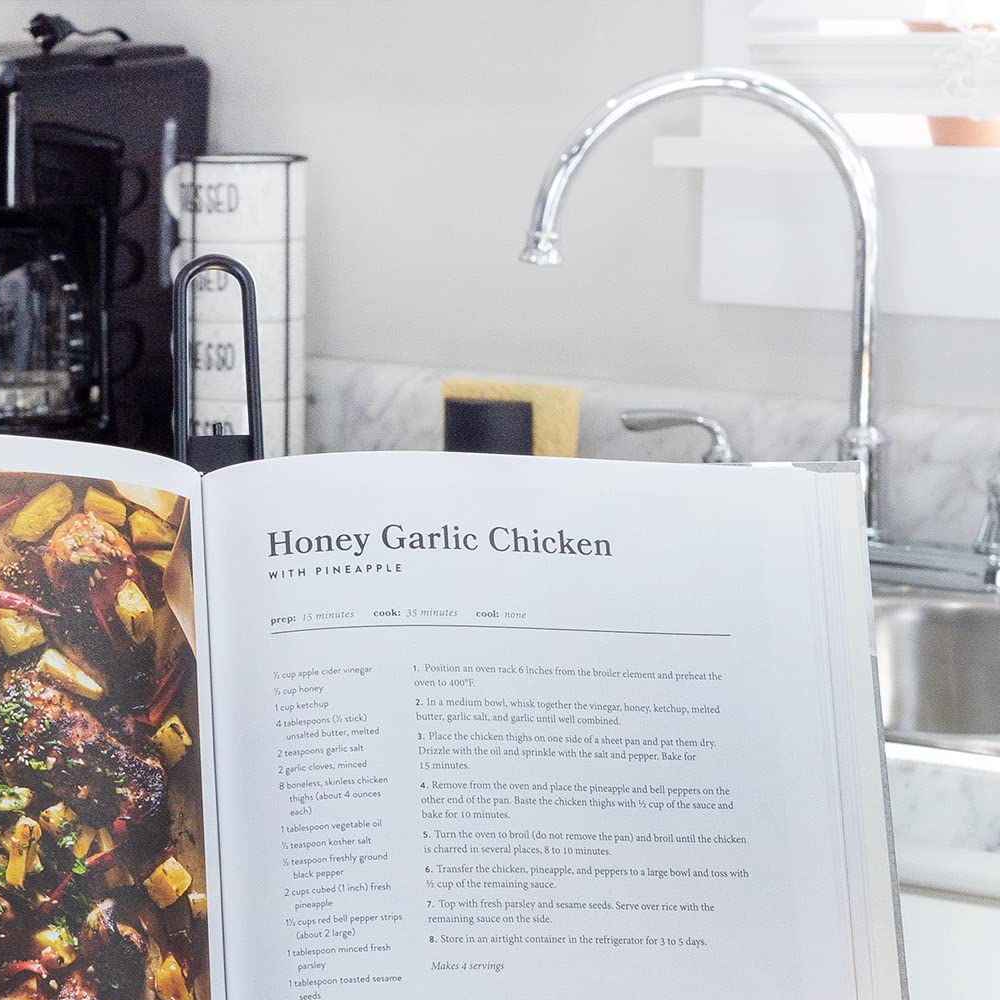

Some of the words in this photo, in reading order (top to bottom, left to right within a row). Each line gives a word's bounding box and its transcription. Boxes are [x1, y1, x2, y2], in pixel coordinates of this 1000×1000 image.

[267, 529, 371, 557] Honey
[381, 524, 478, 551] Garlic
[488, 526, 613, 557] Chicken
[268, 568, 306, 580] WITH
[315, 563, 402, 576] PINEAPPLE
[270, 615, 296, 627] prep:
[303, 613, 312, 622] 15
[316, 610, 354, 620] minutes
[373, 608, 401, 617] cook:
[406, 609, 418, 618] 35
[420, 607, 458, 617] minutes
[475, 609, 500, 618] cool:
[281, 672, 297, 681] cup
[298, 667, 320, 680] apple
[321, 666, 342, 676] cider
[343, 667, 373, 676] vinegar
[424, 663, 461, 673] Position
[498, 664, 517, 674] rack
[518, 665, 524, 674] 6
[525, 665, 553, 675] inches
[554, 666, 576, 676] from
[577, 667, 591, 677] the
[592, 667, 621, 678] broiler
[622, 669, 656, 679] element
[657, 670, 674, 680] and
[675, 671, 707, 683] preheat
[708, 671, 722, 681] the
[437, 679, 447, 687] to
[448, 678, 476, 687] 400°F.
[274, 703, 279, 712] 1
[279, 704, 295, 713] cup
[296, 699, 329, 710] ketchup
[415, 698, 424, 706] 2.
[426, 697, 437, 706] In
[446, 697, 483, 707] medium
[484, 698, 509, 708] bowl,
[509, 698, 536, 709] whisk
[537, 700, 572, 712] together
[573, 700, 588, 710] the
[589, 702, 623, 714] vinegar,
[623, 702, 652, 715] honey,
[653, 703, 690, 716] ketchup,
[691, 704, 721, 714] melted
[286, 729, 320, 741] unsalted
[321, 729, 350, 738] butter,
[350, 726, 380, 736] melted
[277, 749, 283, 758] 2
[284, 748, 324, 759] teaspoons
[326, 744, 348, 757] garlic
[349, 743, 364, 753] salt
[278, 765, 284, 774] 2
[285, 763, 308, 777] garlic
[307, 762, 336, 772] cloves,
[337, 759, 367, 769] minced
[420, 761, 430, 771] 15
[432, 760, 471, 770] minutes.
[278, 781, 285, 791] 8
[286, 779, 323, 790] boneless,
[324, 777, 356, 786] skinless
[356, 775, 389, 785] chicken
[289, 792, 314, 805] thighs
[315, 791, 342, 801] (about
[343, 790, 350, 798] 4
[352, 791, 382, 799] ounces
[290, 805, 313, 817] each)
[281, 825, 284, 833] 1
[286, 823, 330, 834] tablespoon
[331, 819, 371, 832] vegetable
[372, 819, 382, 828] oil
[424, 865, 434, 874] 6.
[435, 863, 474, 873] Transfer
[475, 863, 490, 874] the
[491, 864, 529, 875] chicken,
[530, 865, 575, 877] pineapple,
[576, 865, 593, 875] and
[594, 868, 628, 878] peppers
[629, 868, 639, 876] to
[647, 867, 668, 880] large
[669, 867, 691, 877] bowl
[692, 868, 710, 878] and
[710, 870, 728, 878] toss
[729, 868, 749, 878] with
[284, 888, 290, 897] 2
[291, 888, 310, 898] cups
[311, 883, 336, 895] cubed
[337, 883, 345, 894] (1
[347, 882, 369, 892] inch)
[370, 882, 391, 891] fresh
[294, 898, 333, 913] pineapple
[426, 900, 435, 908] 7.
[437, 899, 456, 911] Top
[458, 898, 478, 908] with
[480, 898, 503, 908] fresh
[504, 899, 536, 911] parsley
[537, 899, 554, 909] and
[588, 900, 614, 910] seeds.
[615, 901, 639, 911] Serve
[640, 903, 660, 911] over
[661, 902, 678, 912] rice
[679, 902, 699, 912] with
[700, 902, 715, 912] the
[429, 935, 438, 943] 8.
[440, 934, 464, 944] Store
[466, 934, 475, 943] in
[490, 933, 523, 946] airtight
[524, 935, 566, 944] container
[568, 935, 577, 944] in
[579, 934, 593, 944] the
[595, 934, 644, 947] refrigerator
[645, 935, 658, 945] for
[660, 937, 666, 946] 3
[667, 937, 677, 946] to
[678, 937, 684, 947] 5
[685, 936, 708, 949] days.
[287, 949, 291, 957] 1
[292, 947, 336, 958] tablespoon
[338, 943, 369, 953] minced
[370, 943, 391, 952] fresh
[297, 960, 326, 973] parsley
[431, 961, 459, 971] Makes
[461, 962, 467, 971] 4
[469, 961, 505, 973] servings
[288, 979, 292, 988] 1
[294, 977, 338, 989] tablespoon
[339, 974, 371, 984] toasted
[299, 990, 322, 1000] seeds
